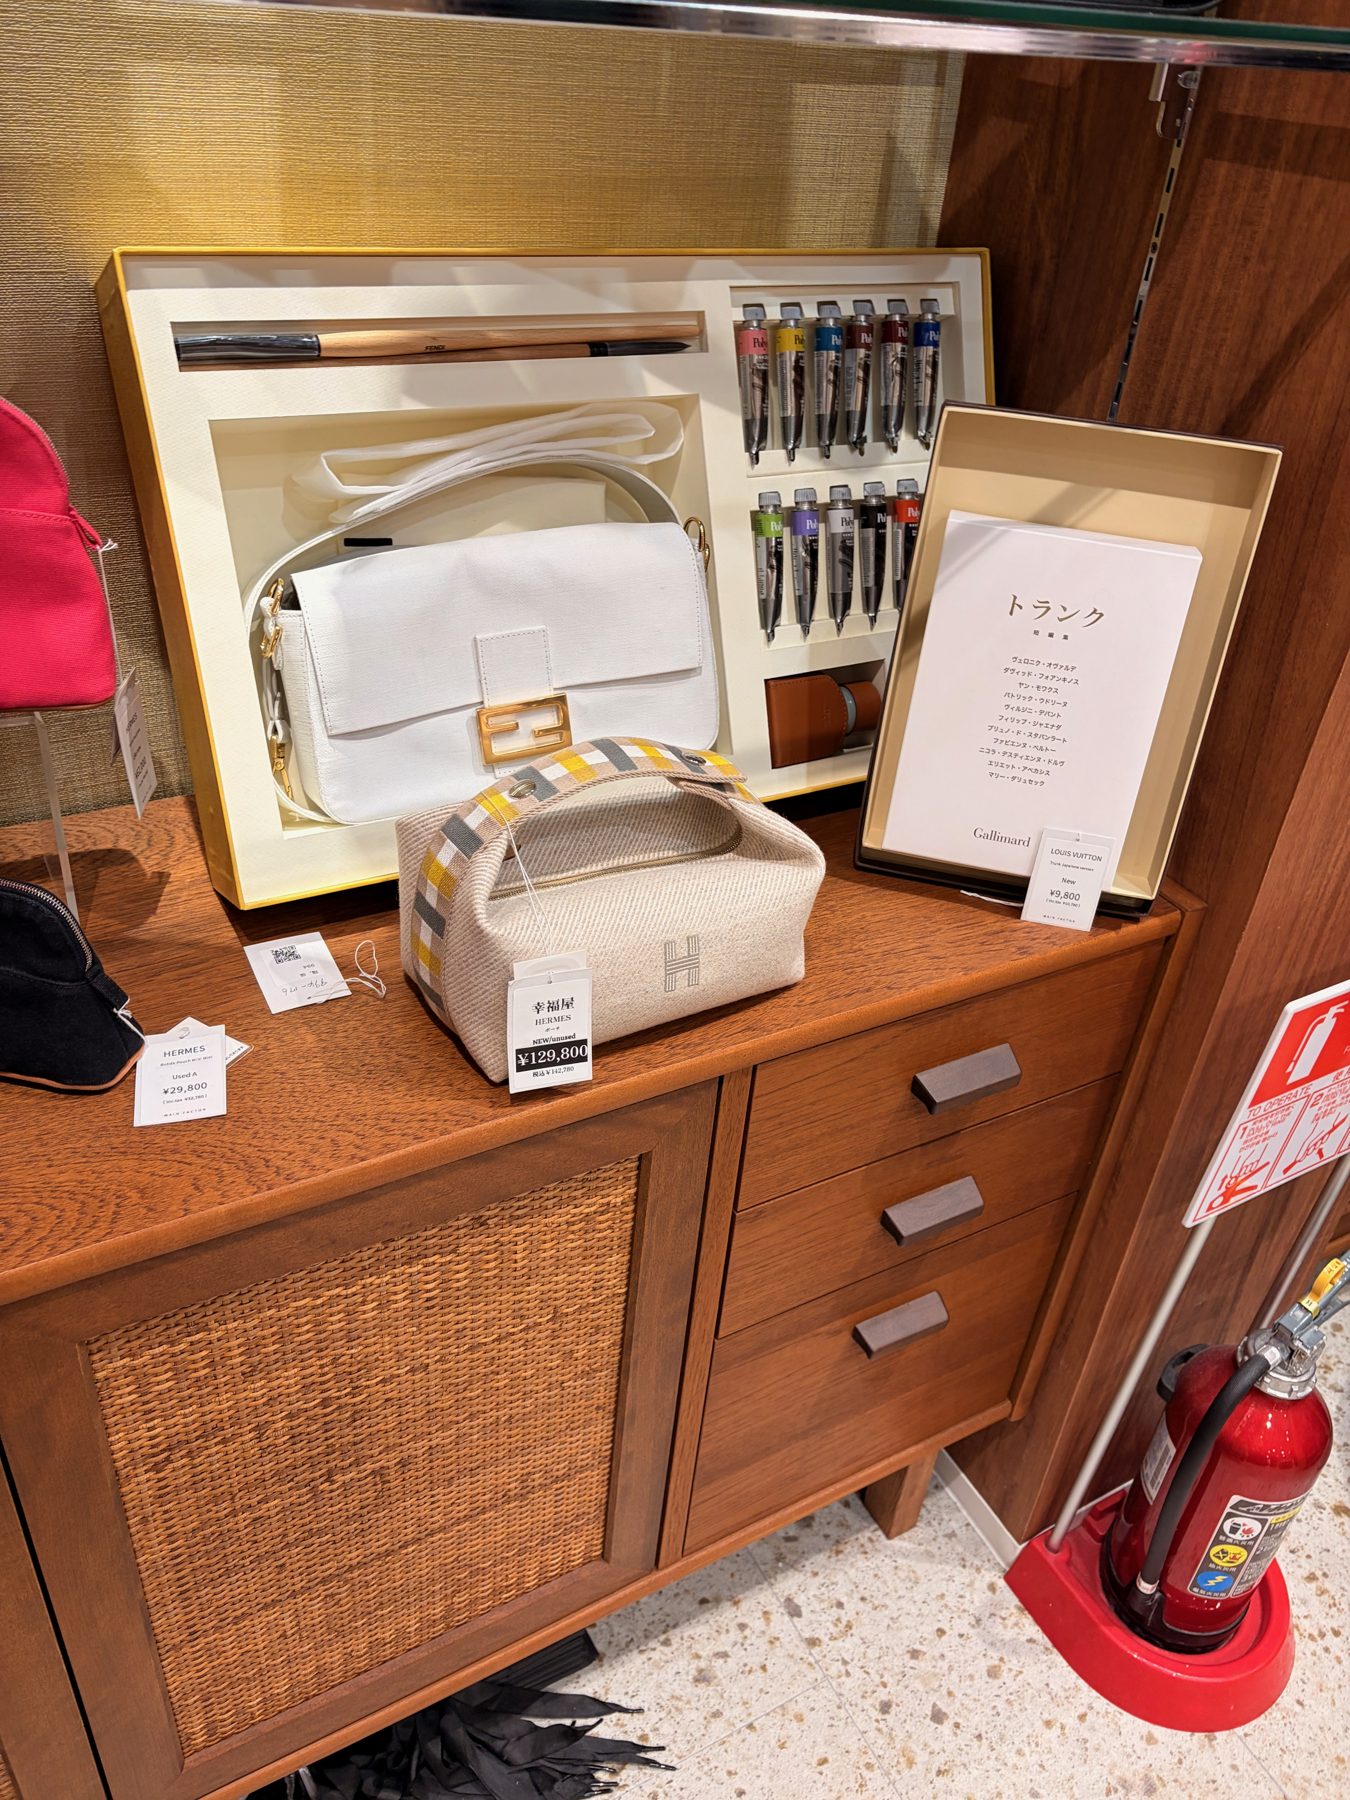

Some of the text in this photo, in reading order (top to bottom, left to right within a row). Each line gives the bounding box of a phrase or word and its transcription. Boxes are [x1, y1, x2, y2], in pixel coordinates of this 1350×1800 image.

[424, 344, 446, 352] FENDI
[1008, 594, 1105, 628] トランク
[973, 826, 1031, 848] Gallimard
[1050, 848, 1103, 862] LOUIS VUITTON
[1061, 876, 1077, 886] New
[1049, 889, 1081, 902] ¥9,800
[532, 996, 575, 1014] 幸福屋
[535, 1014, 572, 1026] HERMES
[532, 1033, 576, 1046] NEW/unused
[163, 1045, 206, 1058] HERMES
[517, 1044, 588, 1066] ¥129,800
[172, 1072, 191, 1080] Used
[163, 1081, 208, 1095] ¥29,800
[1247, 1105, 1262, 1119] TO
[1263, 1083, 1313, 1112] OPERATE
[1310, 1092, 1324, 1109] 2
[1240, 1125, 1249, 1140] 1
